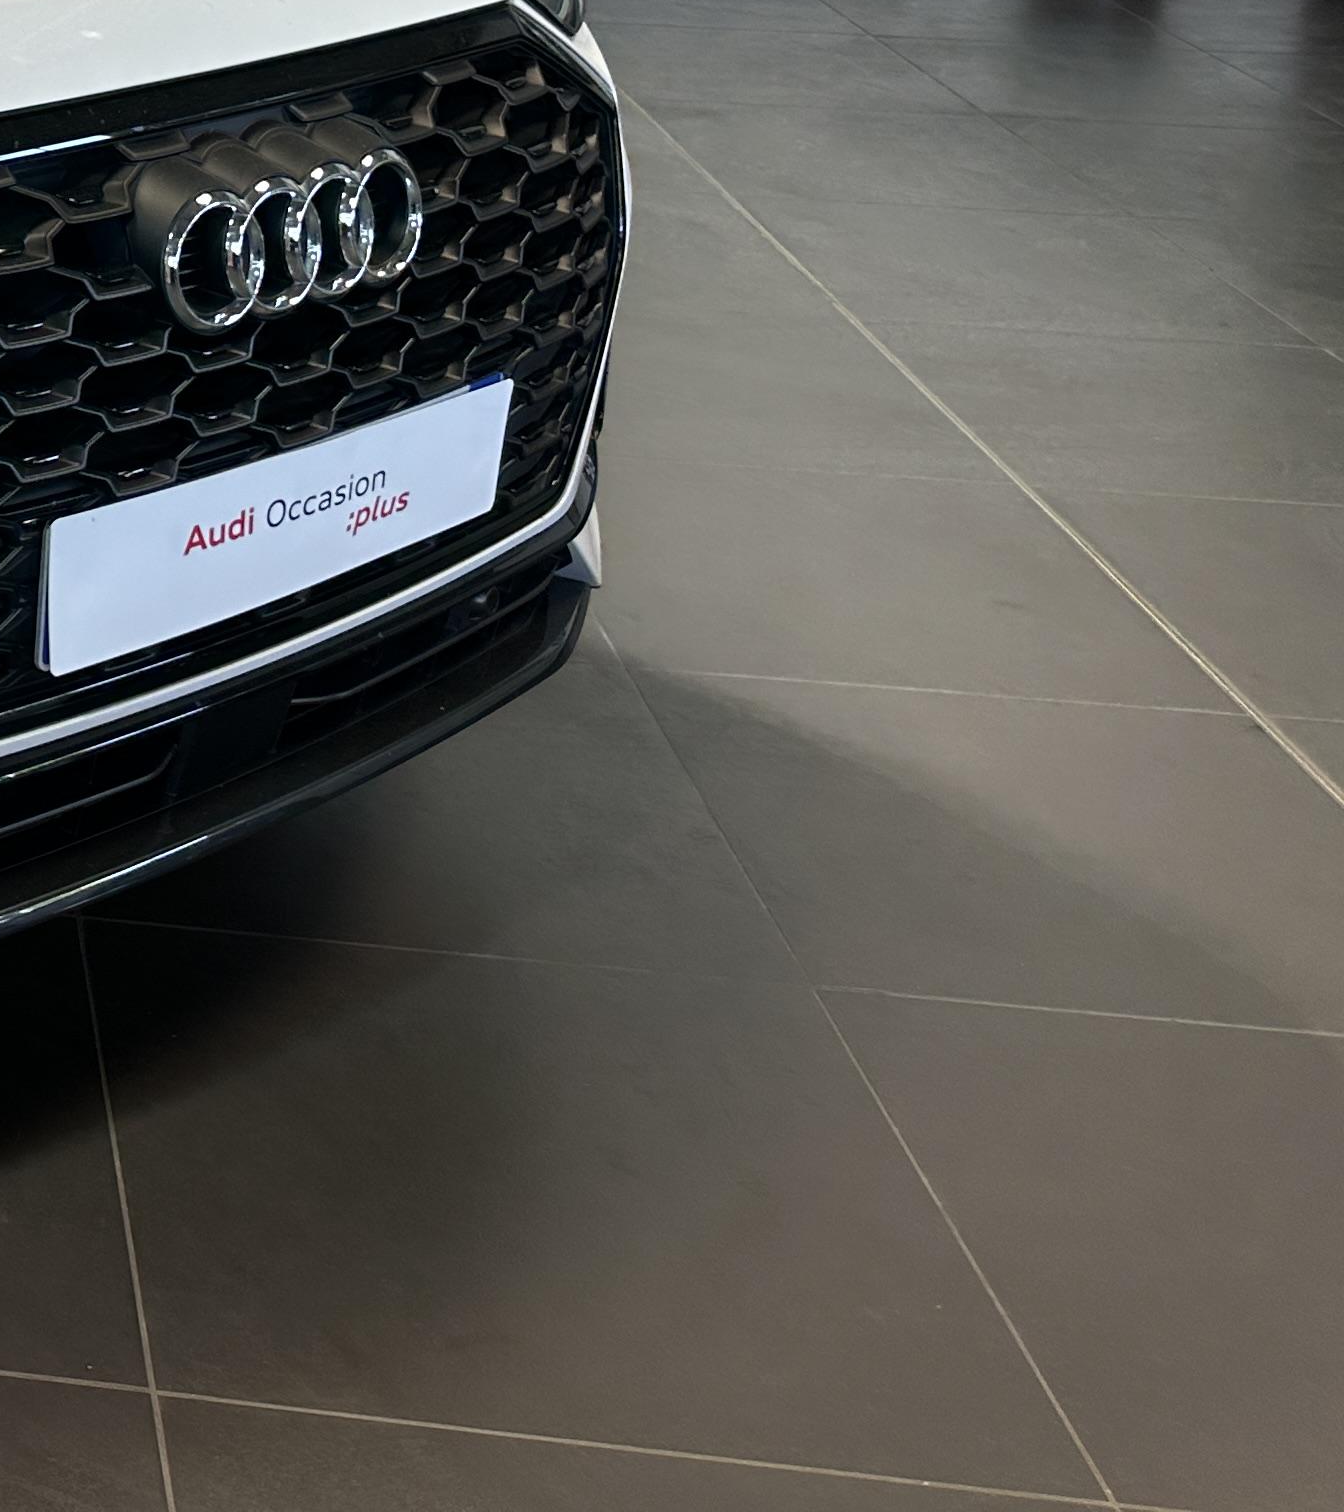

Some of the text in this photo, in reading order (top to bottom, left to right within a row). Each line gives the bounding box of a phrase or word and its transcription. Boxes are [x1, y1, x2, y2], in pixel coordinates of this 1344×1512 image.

[182, 468, 387, 556] Audi Occasion
[344, 490, 410, 537] :plus
